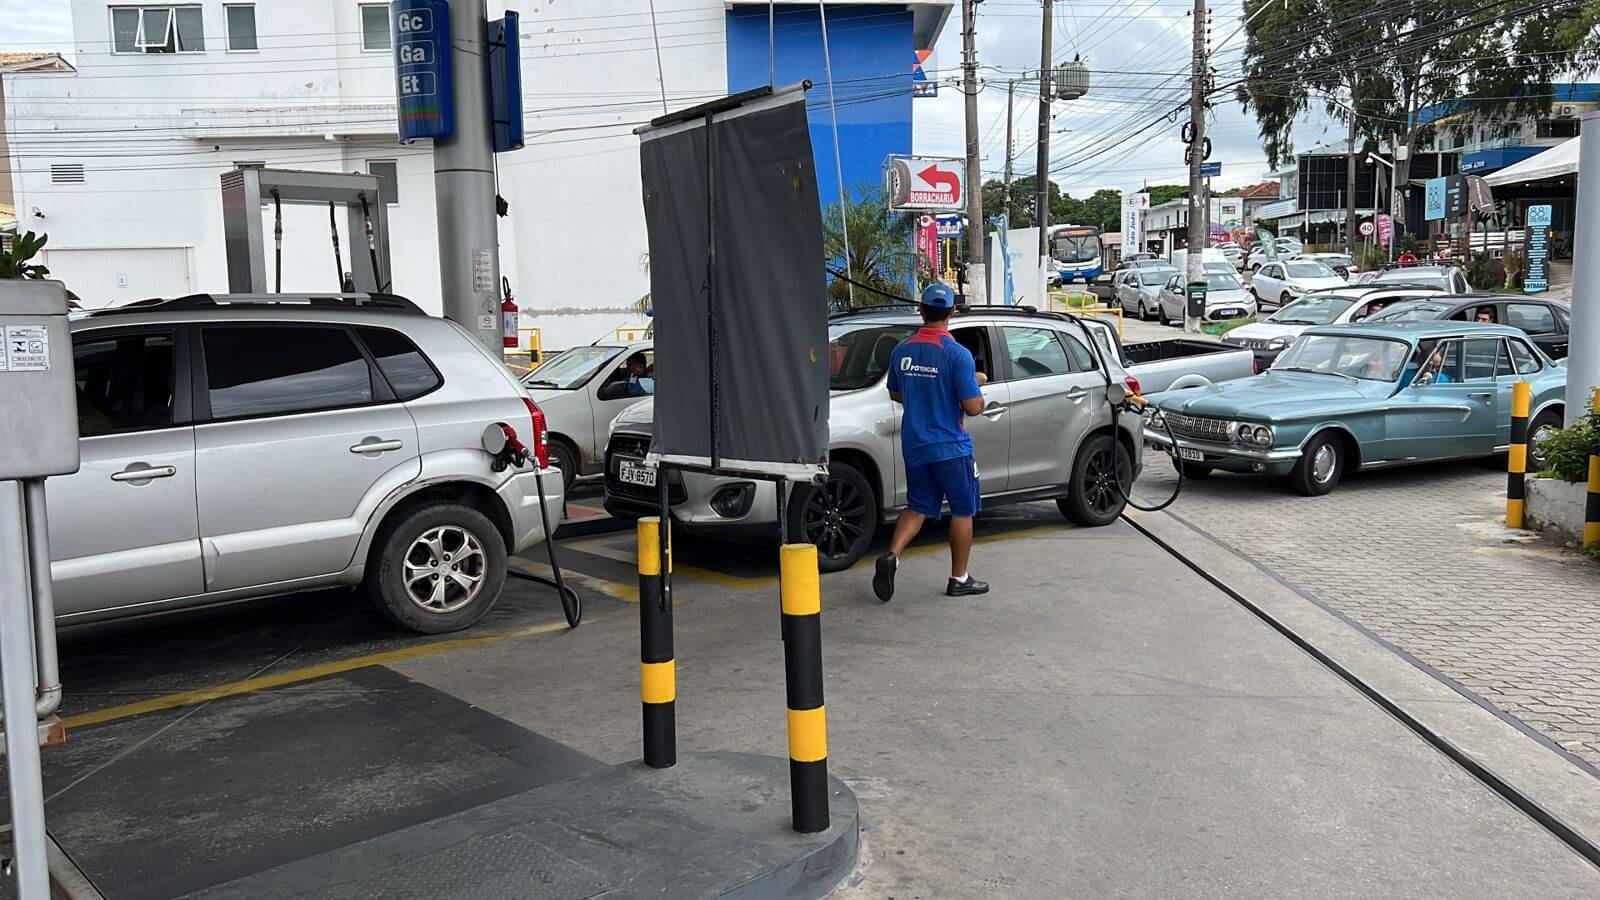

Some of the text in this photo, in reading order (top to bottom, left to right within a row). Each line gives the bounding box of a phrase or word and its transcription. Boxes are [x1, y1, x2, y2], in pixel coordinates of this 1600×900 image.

[398, 13, 424, 32] Gc
[400, 44, 426, 63] Ga
[401, 75, 420, 94] Et
[910, 192, 954, 204] BORRACHARIA
[1361, 224, 1373, 232] 40
